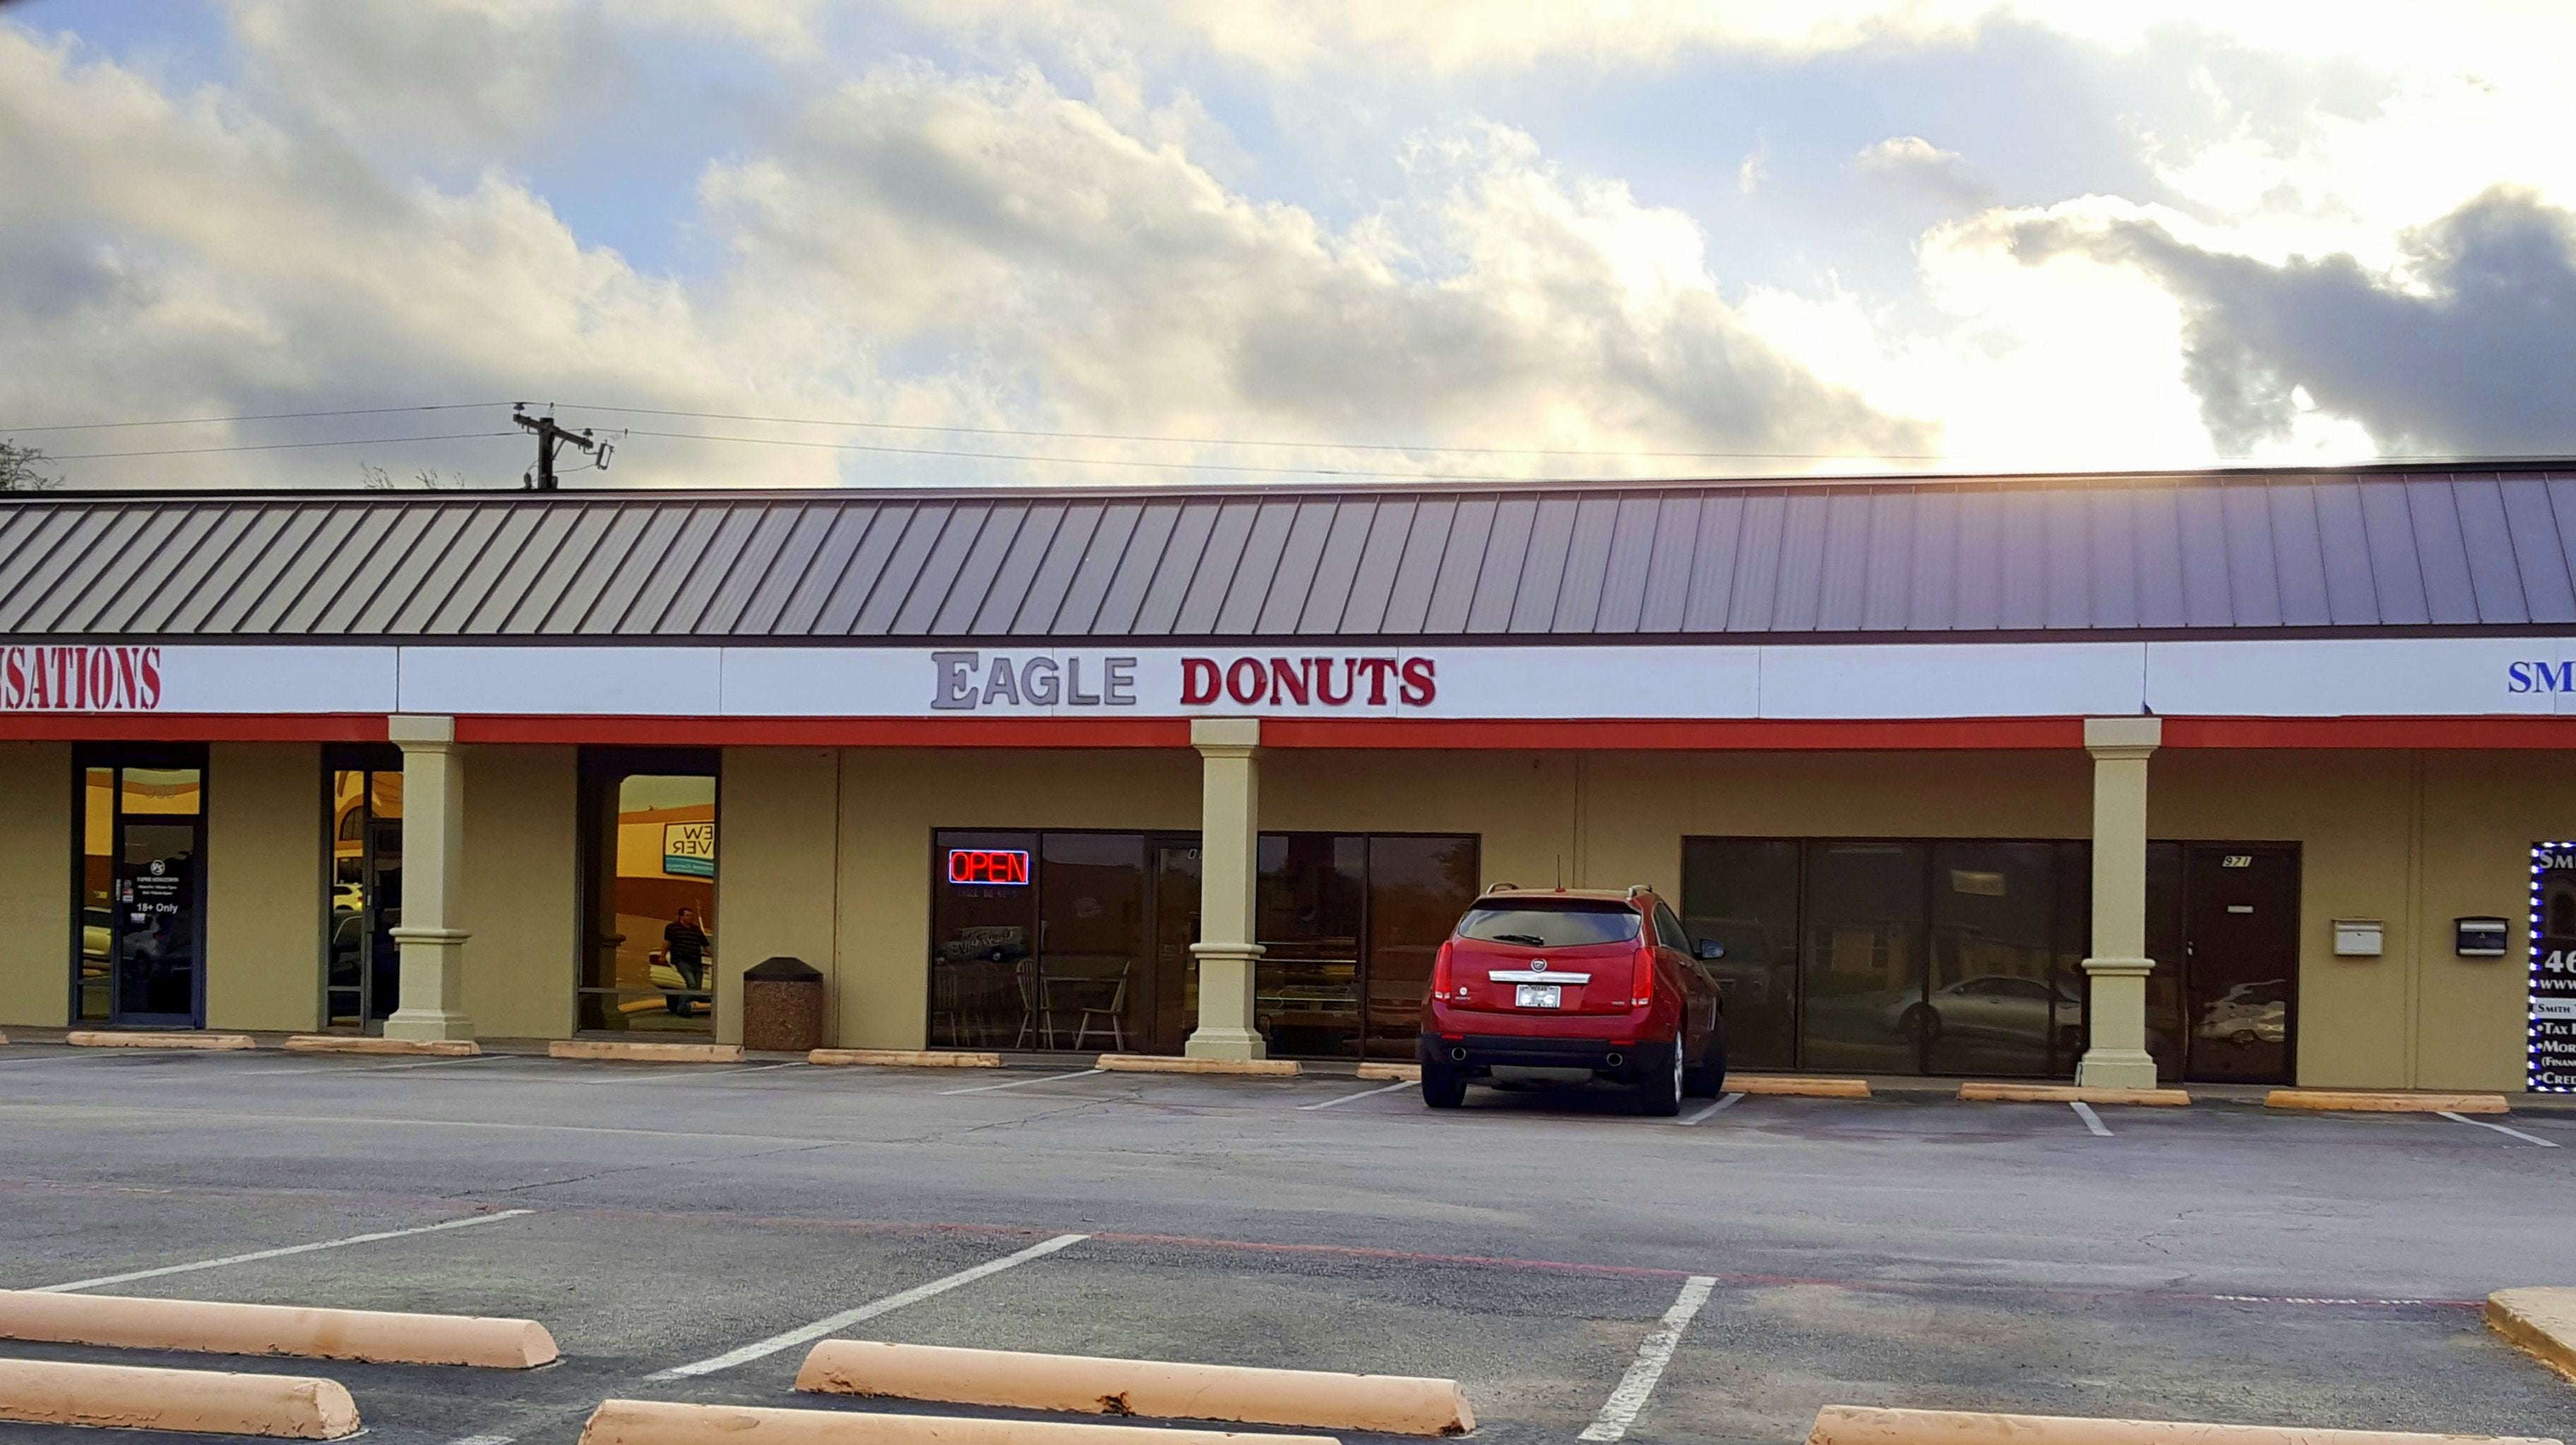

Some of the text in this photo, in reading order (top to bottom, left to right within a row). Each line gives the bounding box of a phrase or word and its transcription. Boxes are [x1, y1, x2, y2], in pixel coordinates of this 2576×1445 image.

[931, 651, 1436, 710] EAGLE DONUTS
[951, 851, 1027, 882] OPEN
[2224, 856, 2250, 867] 971
[136, 903, 179, 915] 18+ Only
